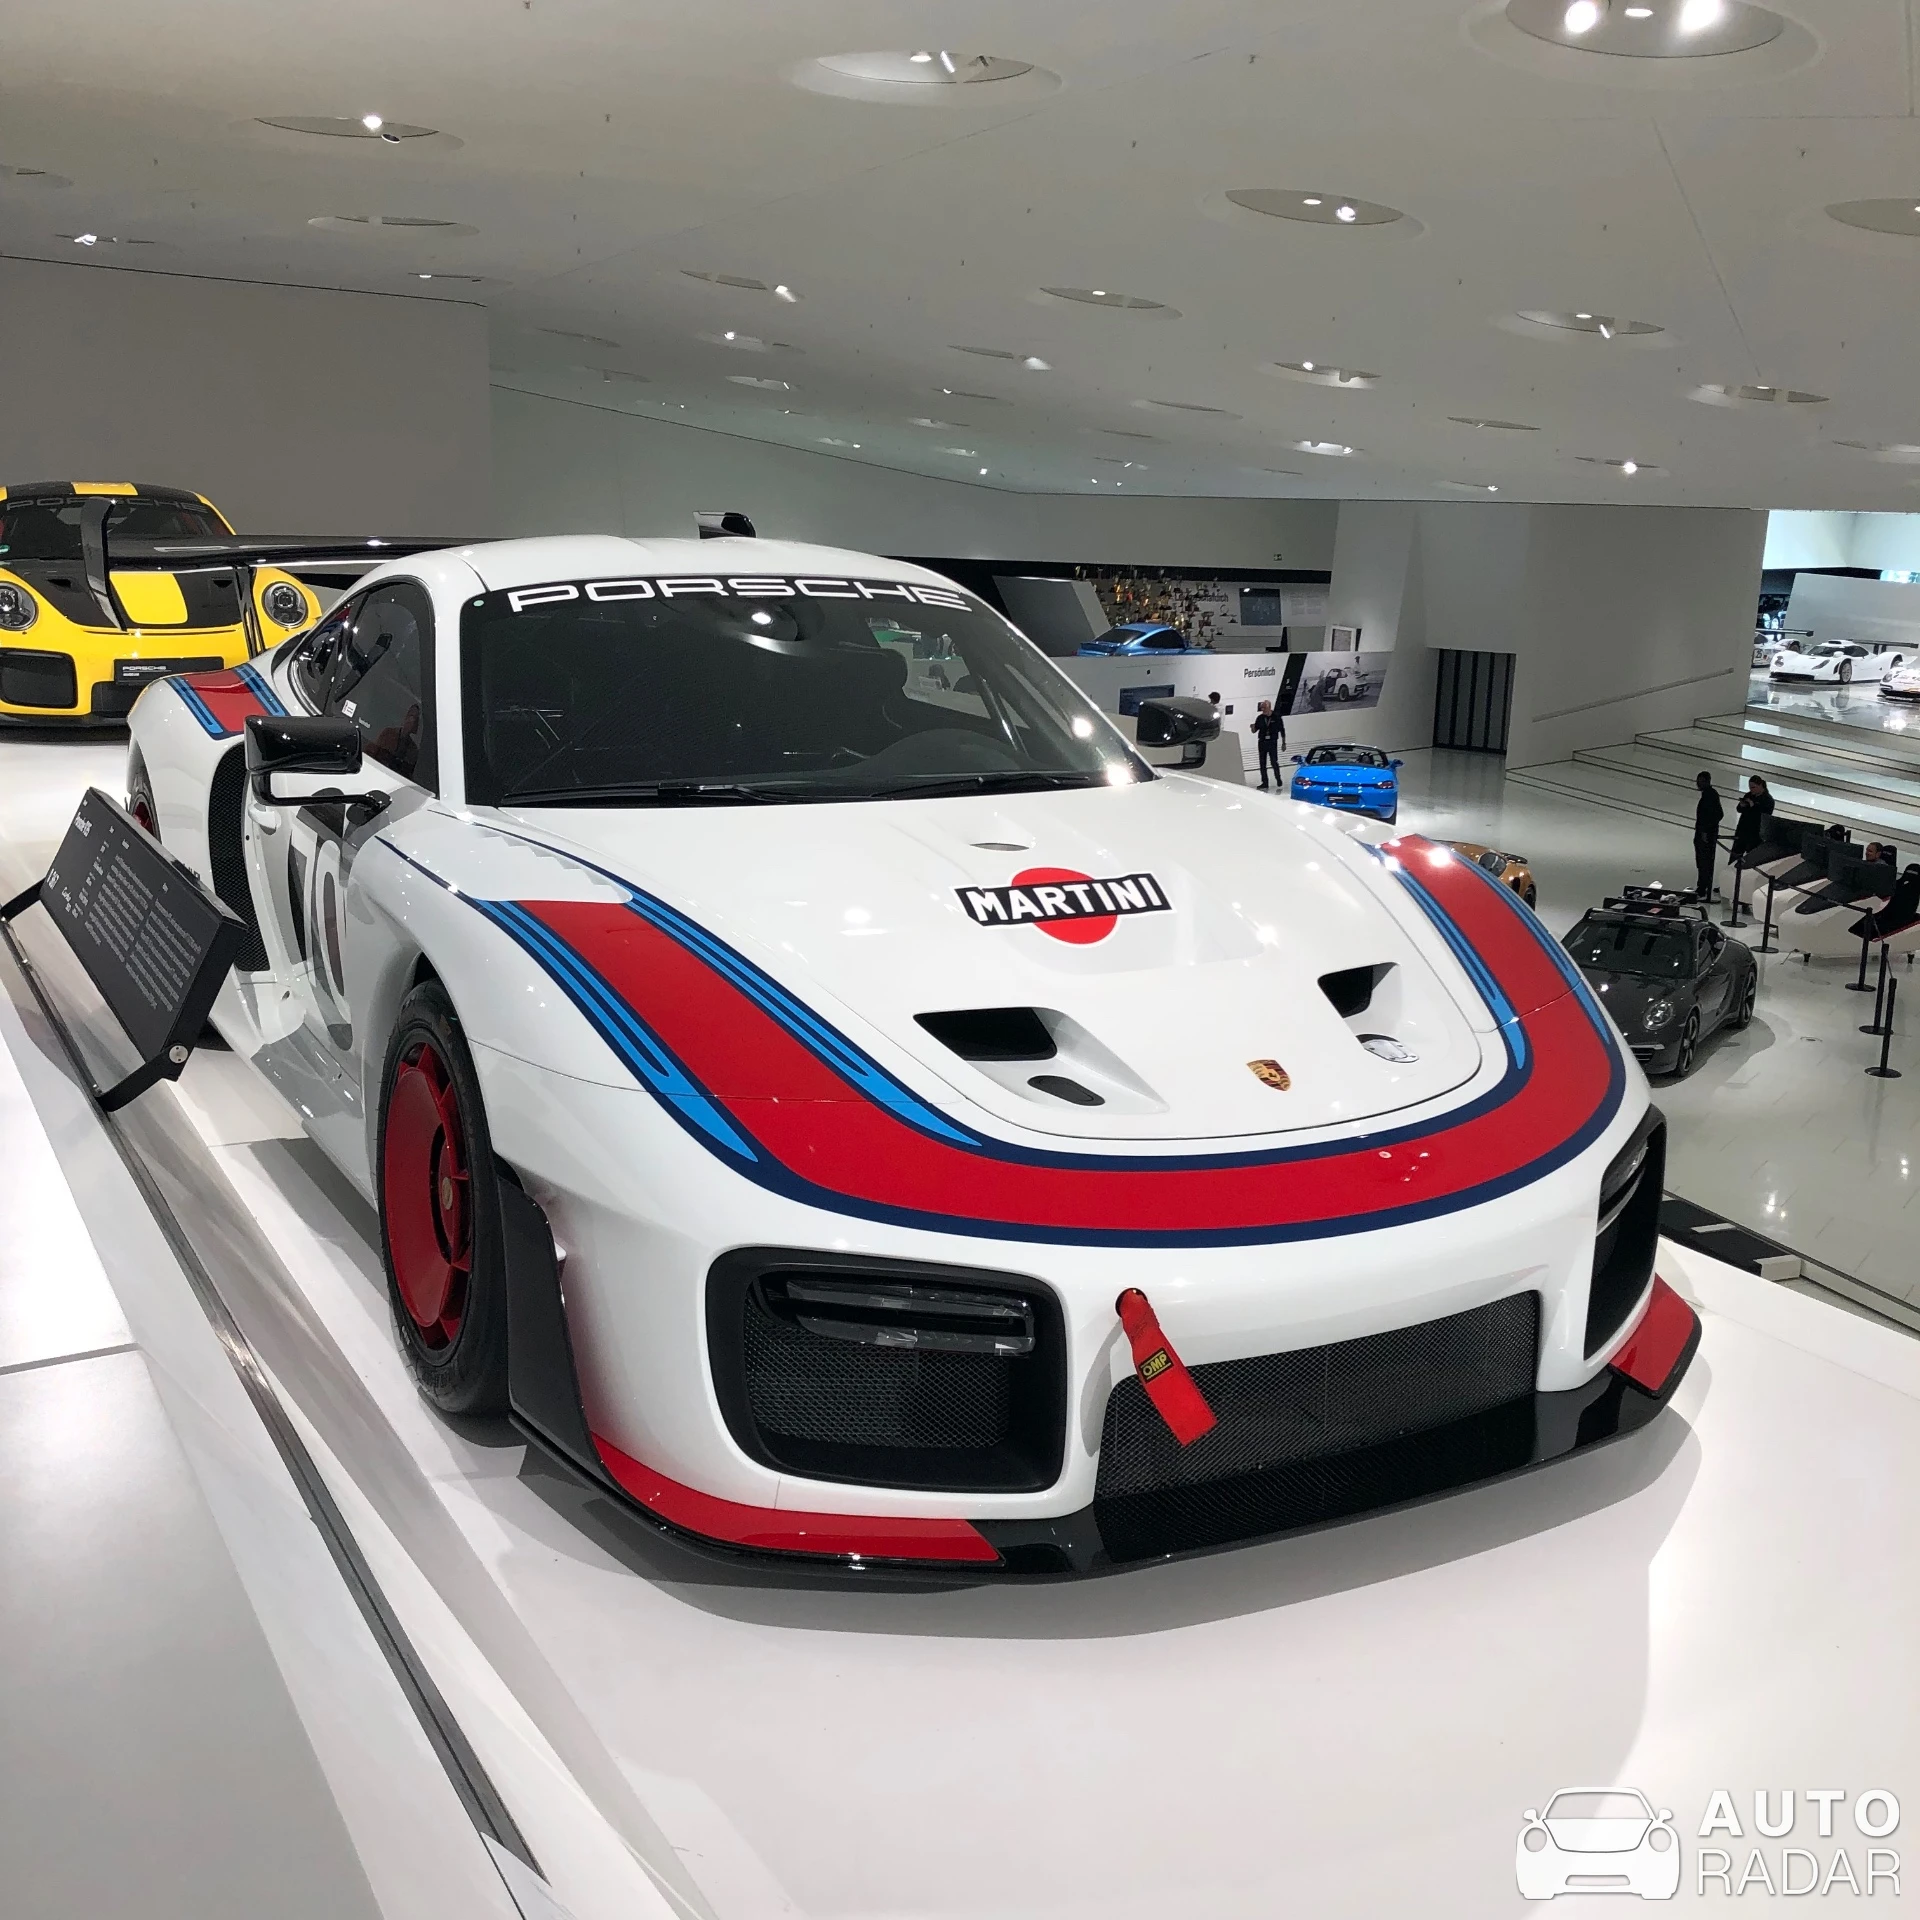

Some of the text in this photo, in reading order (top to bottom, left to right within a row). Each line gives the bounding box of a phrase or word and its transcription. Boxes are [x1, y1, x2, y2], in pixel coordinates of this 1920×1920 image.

[508, 578, 972, 612] PORSCHE
[1244, 667, 1276, 678] Persönlich
[965, 877, 1162, 922] MARTINI
[1142, 1353, 1167, 1376] OMP
